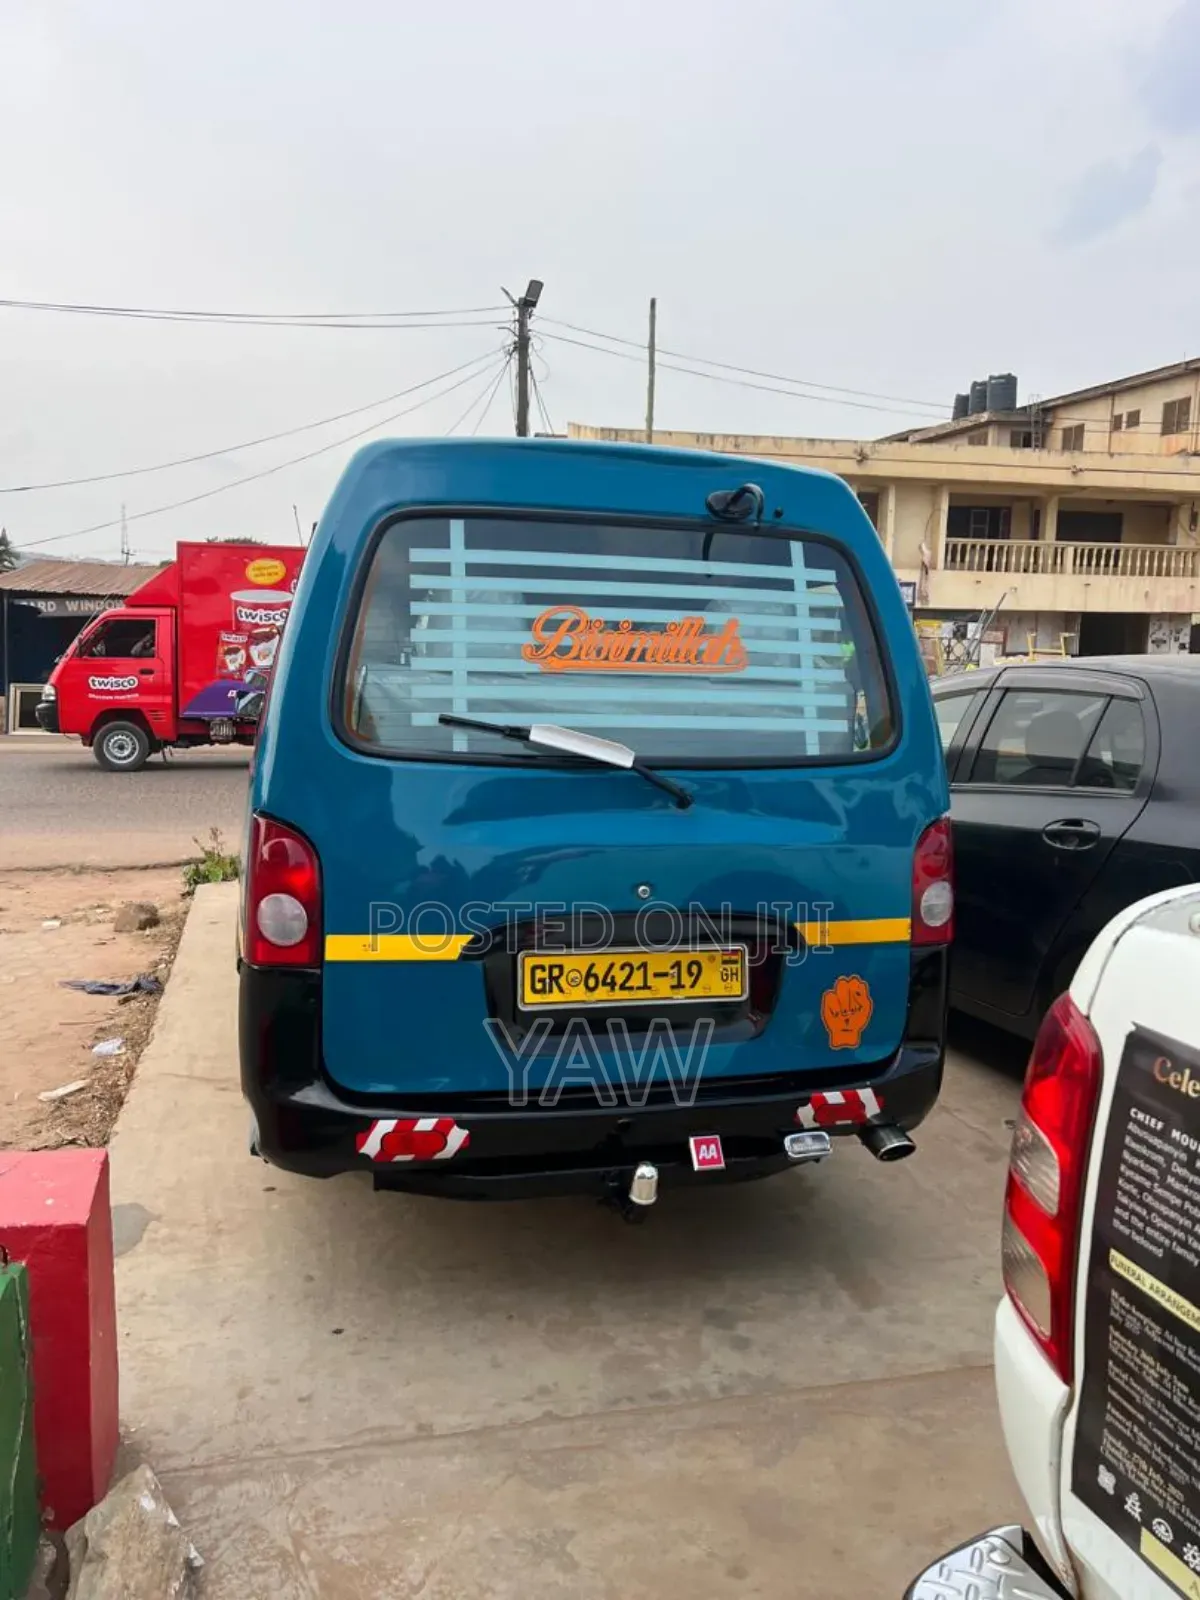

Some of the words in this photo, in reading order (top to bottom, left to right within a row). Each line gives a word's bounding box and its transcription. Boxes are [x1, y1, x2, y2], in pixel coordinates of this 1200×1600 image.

[89, 676, 138, 690] twisco
[530, 963, 565, 995] GR
[583, 959, 703, 991] 6421-19
[720, 966, 739, 983] GH
[1129, 1107, 1165, 1132] CHIEF
[1171, 1128, 1200, 1155] MOU
[699, 1144, 718, 1160] AA
[1110, 1254, 1146, 1287] FUNERAL
